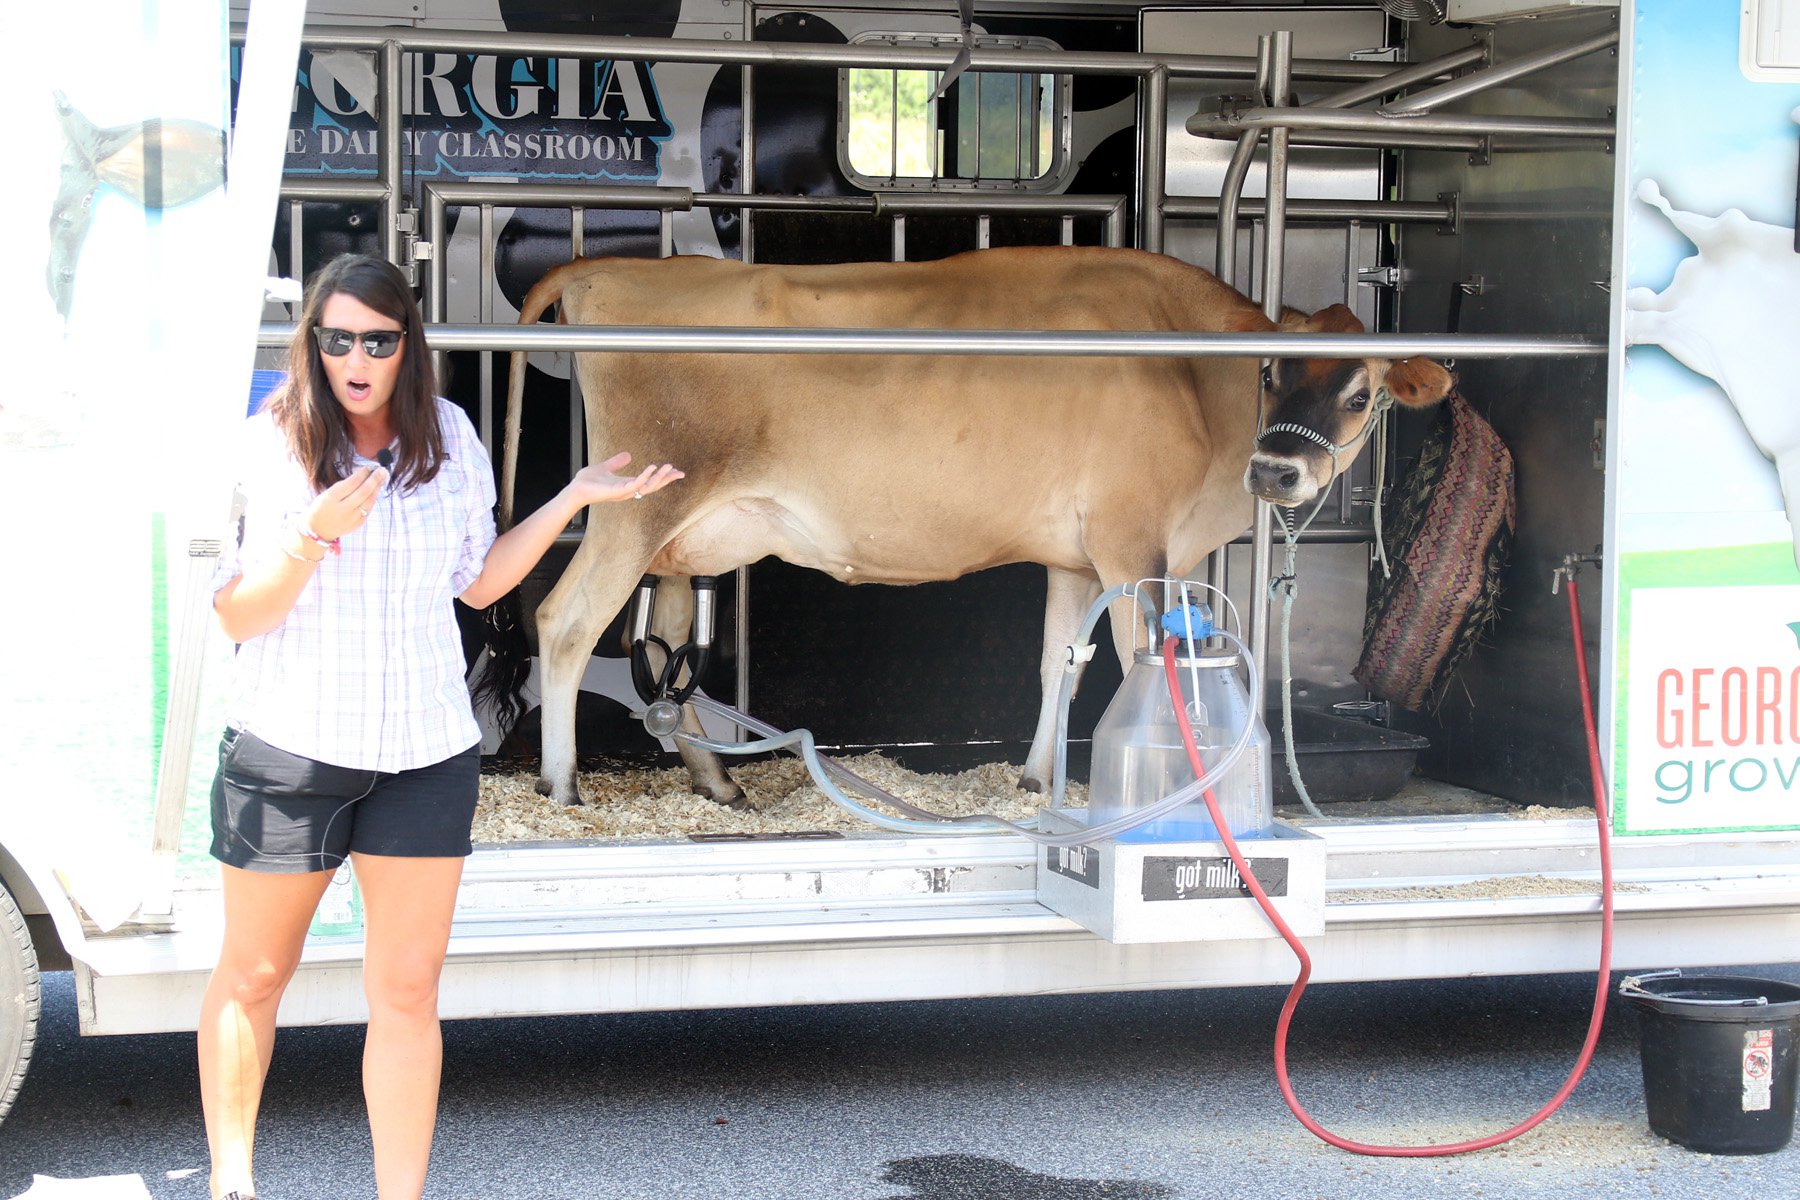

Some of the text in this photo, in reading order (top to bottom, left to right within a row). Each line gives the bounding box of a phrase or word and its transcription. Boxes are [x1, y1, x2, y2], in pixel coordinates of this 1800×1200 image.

[292, 50, 656, 121] ORGIA
[319, 128, 424, 156] DAIY
[439, 131, 643, 161] CLASSROOM
[1176, 859, 1201, 898] got
